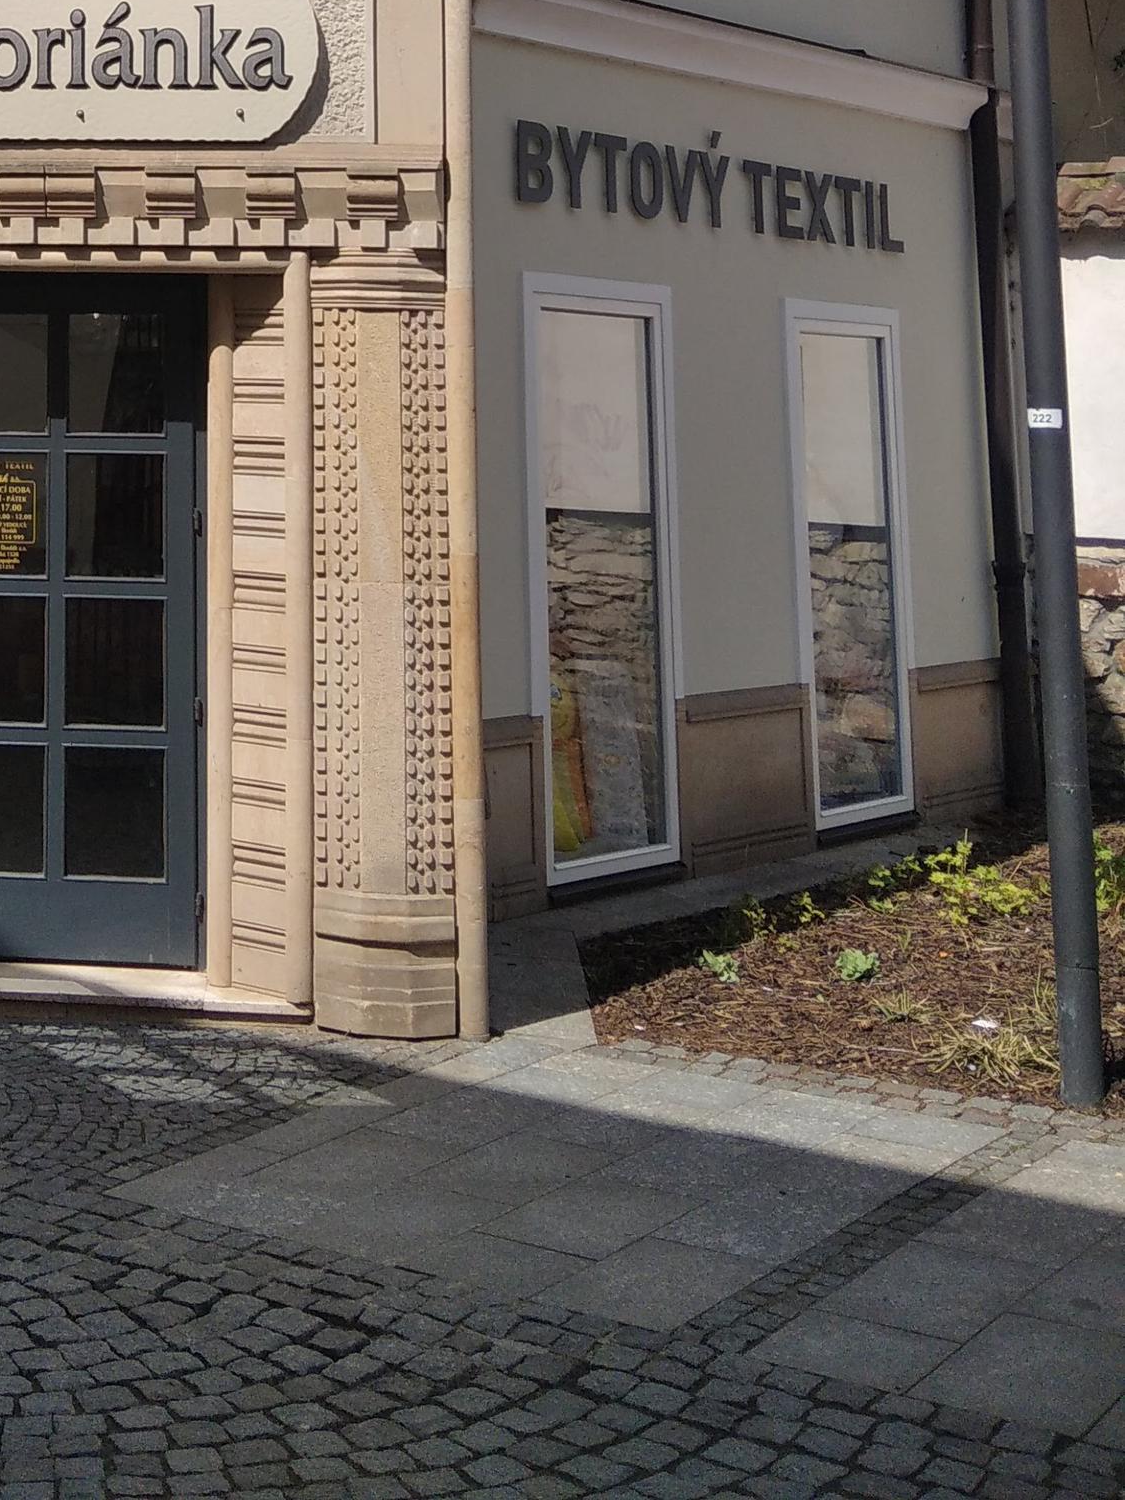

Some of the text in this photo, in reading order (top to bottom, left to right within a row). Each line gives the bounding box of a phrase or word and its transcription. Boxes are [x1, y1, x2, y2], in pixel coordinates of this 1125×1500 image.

[516, 118, 905, 254] BYTOVÝ TEXTIL
[1032, 413, 1052, 424] 222
[8, 485, 31, 494] DOBA
